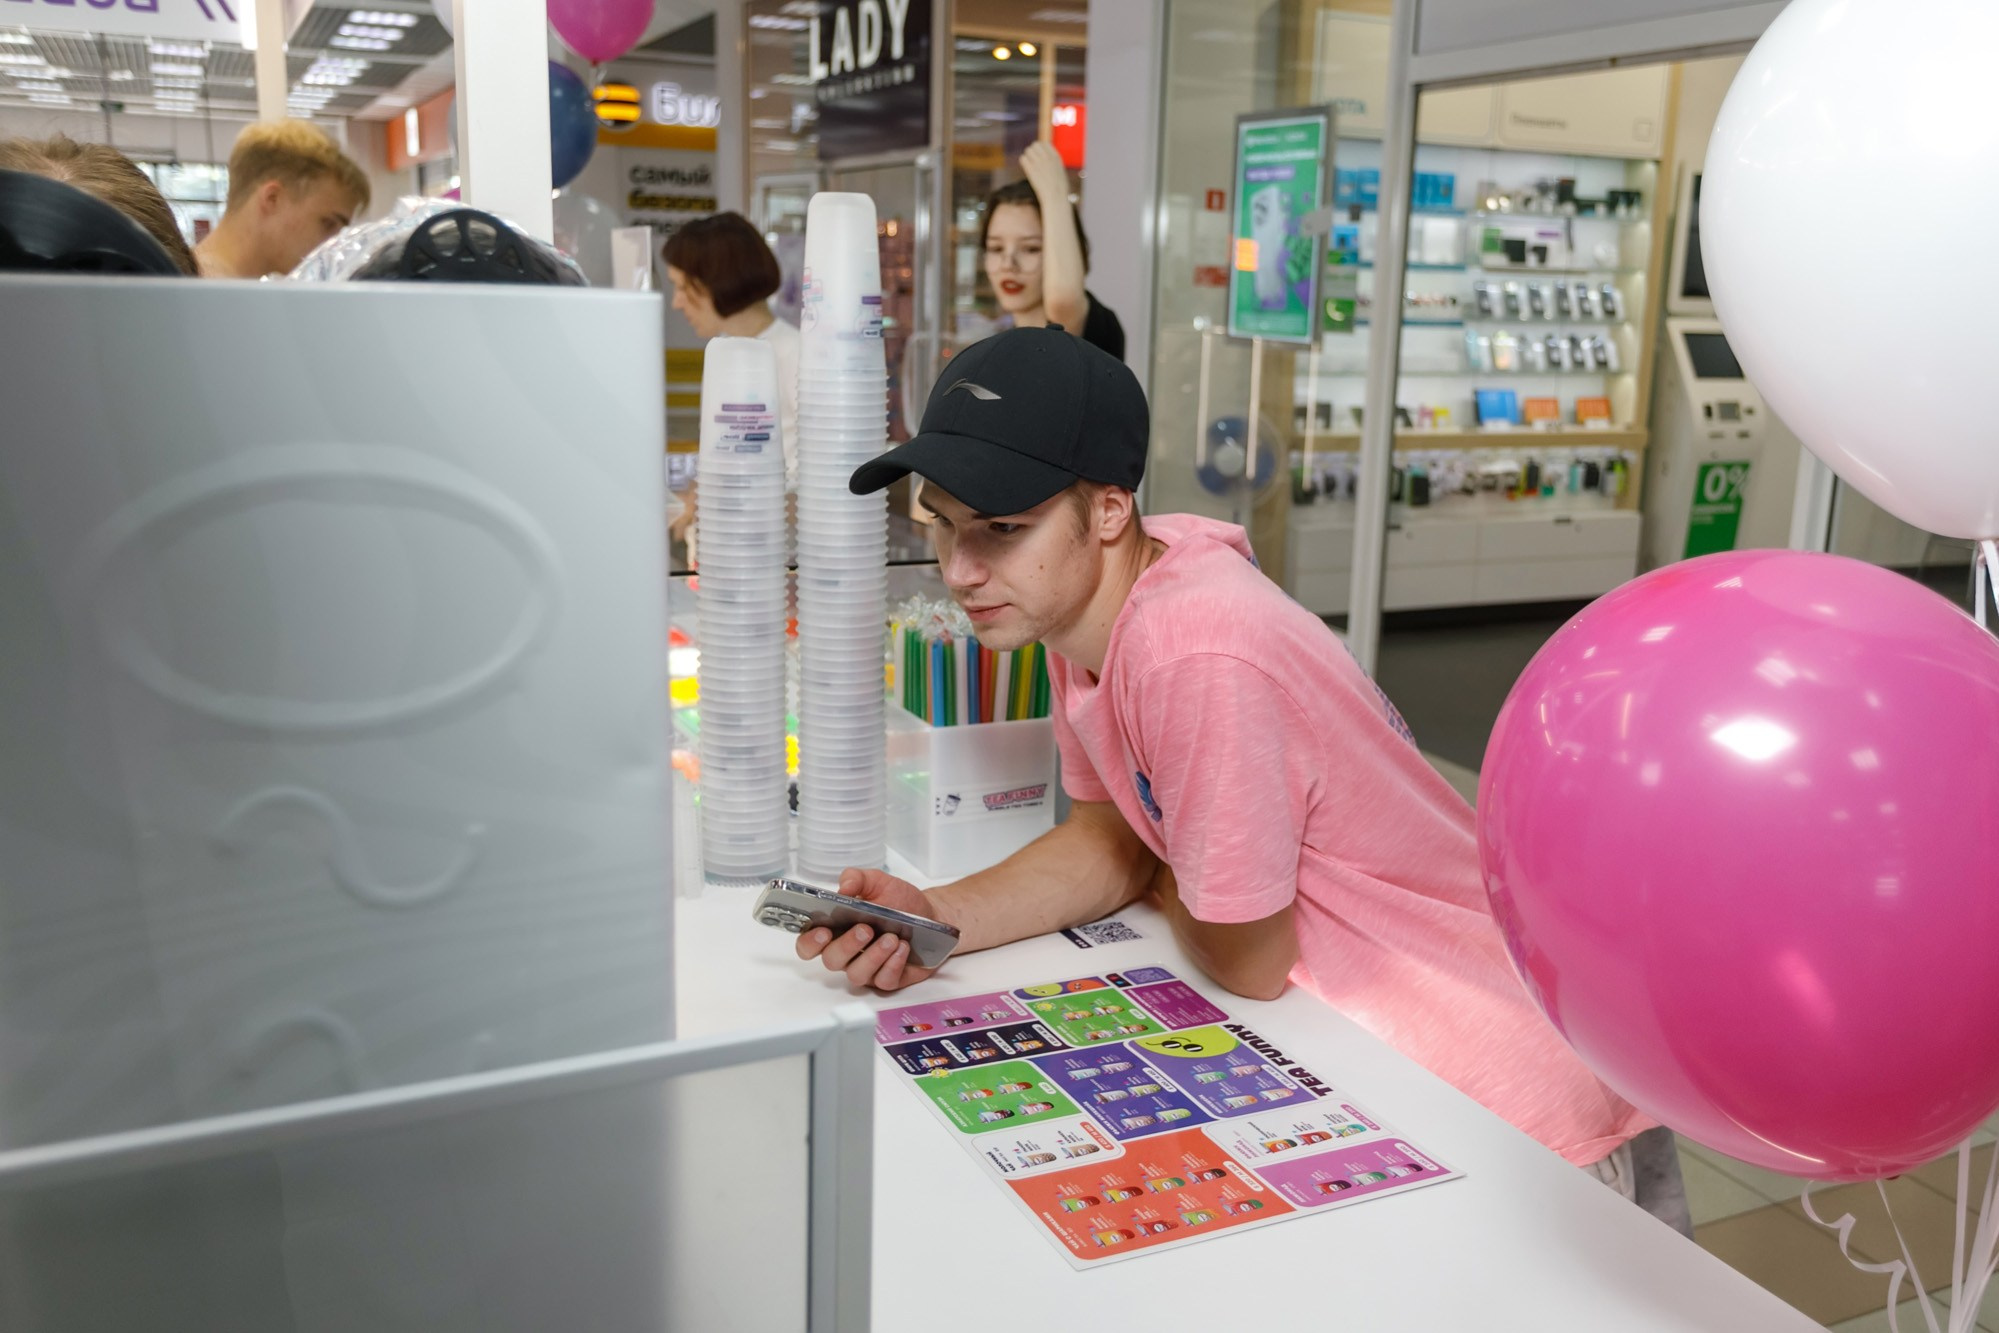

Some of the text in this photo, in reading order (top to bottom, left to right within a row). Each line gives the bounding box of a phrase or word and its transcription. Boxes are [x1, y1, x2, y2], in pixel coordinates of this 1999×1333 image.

[809, 0, 910, 81] LADY
[1221, 1021, 1337, 1097] TEA FUNNY
